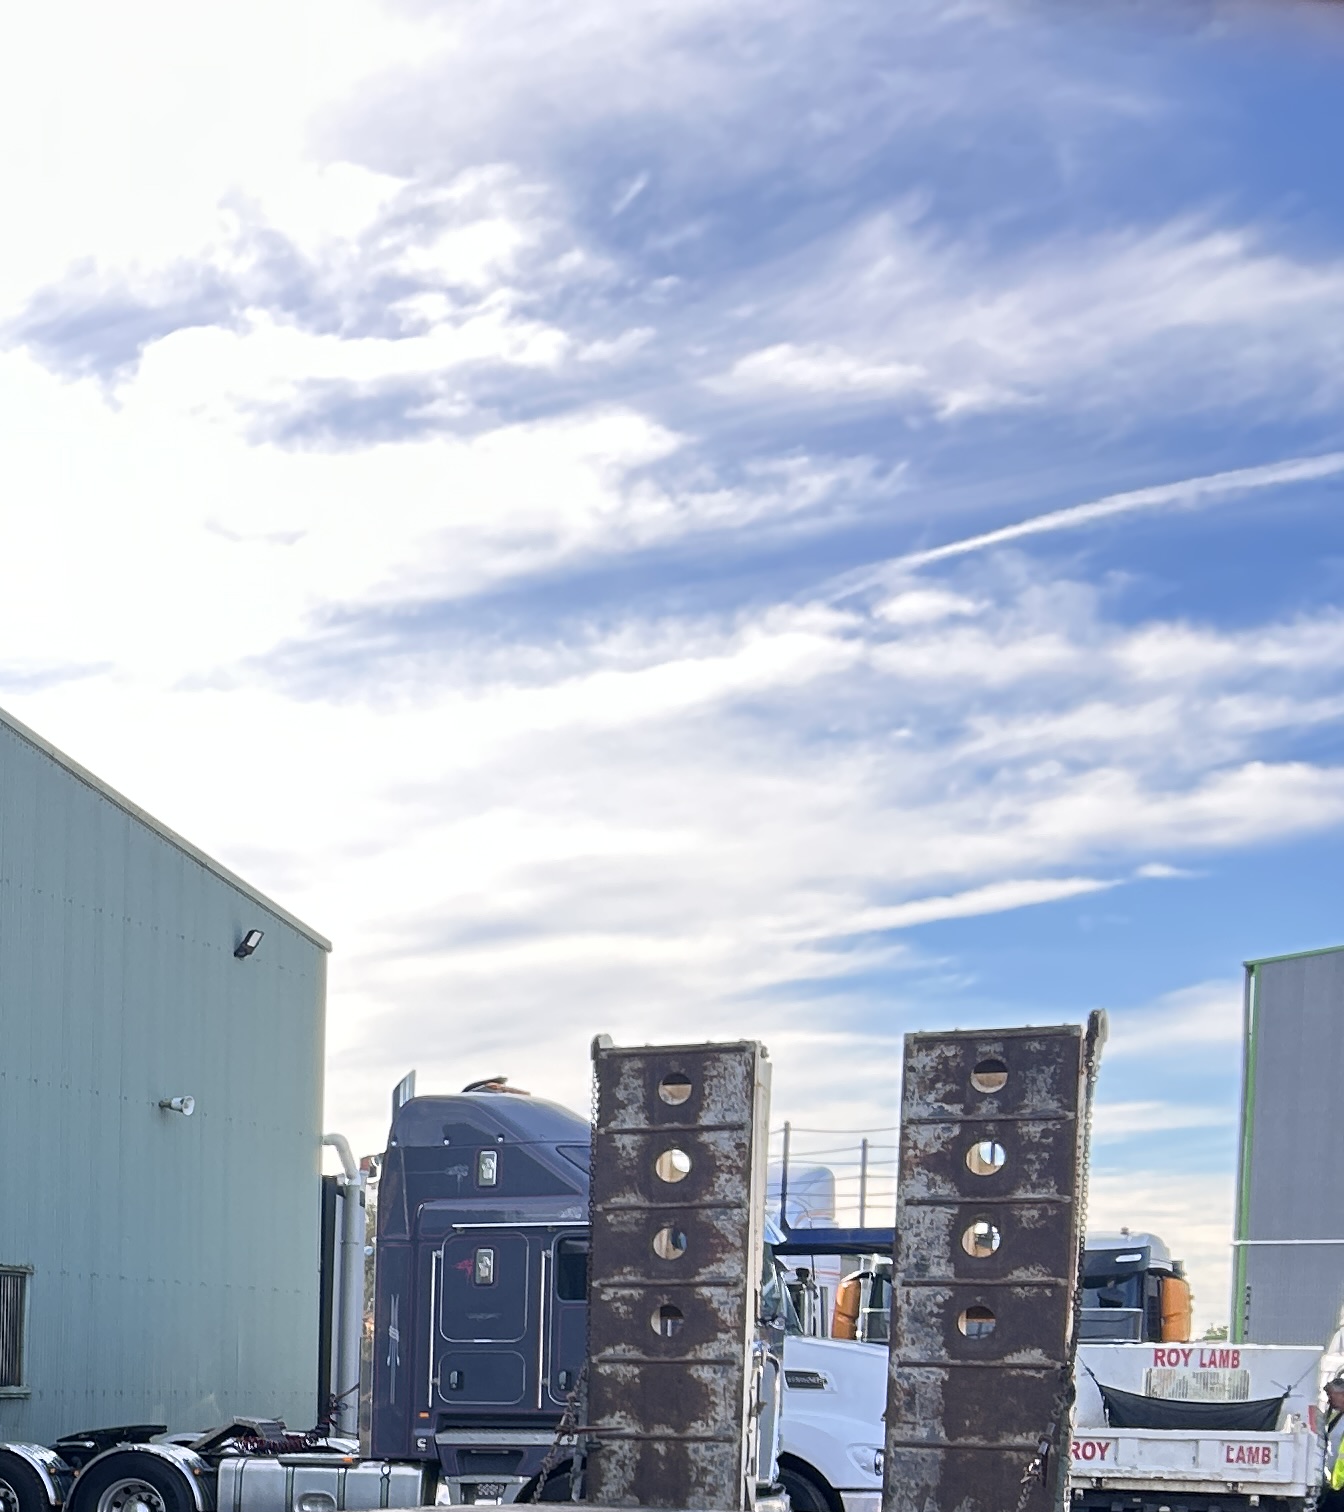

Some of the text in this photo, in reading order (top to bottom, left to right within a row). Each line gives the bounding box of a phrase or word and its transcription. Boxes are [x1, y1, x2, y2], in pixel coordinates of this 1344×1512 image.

[1153, 1348, 1241, 1369] ROY LAMB
[1071, 1441, 1272, 1465] ROY LAMB
